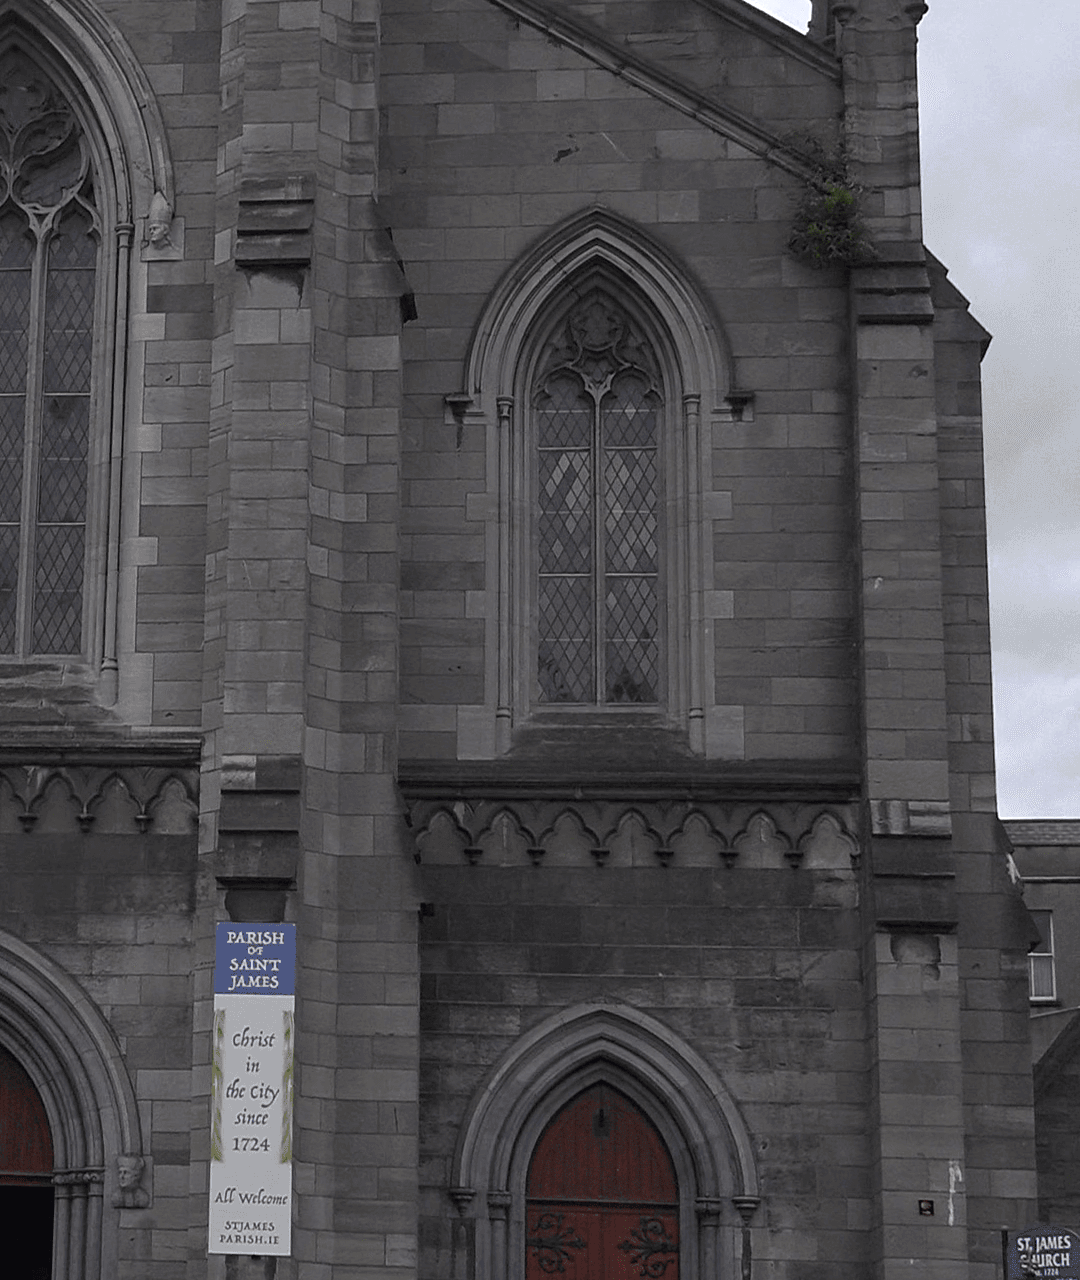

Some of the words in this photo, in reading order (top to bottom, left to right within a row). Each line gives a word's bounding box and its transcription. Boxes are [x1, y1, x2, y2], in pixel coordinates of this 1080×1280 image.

[227, 931, 285, 945] PARISH
[247, 946, 264, 956] OF
[229, 958, 282, 972] SAINT
[228, 975, 280, 991] JAMES
[232, 1027, 275, 1047] Christ
[246, 1057, 260, 1073] in
[226, 1078, 246, 1099] the
[250, 1082, 280, 1108] City
[234, 1108, 269, 1125] since
[232, 1137, 270, 1152] 1724
[214, 1187, 236, 1204] All
[238, 1188, 288, 1205] Welcome
[219, 1234, 280, 1245] PARISH.IE
[1017, 1237, 1033, 1252] ST.
[1036, 1235, 1072, 1253] JAMES
